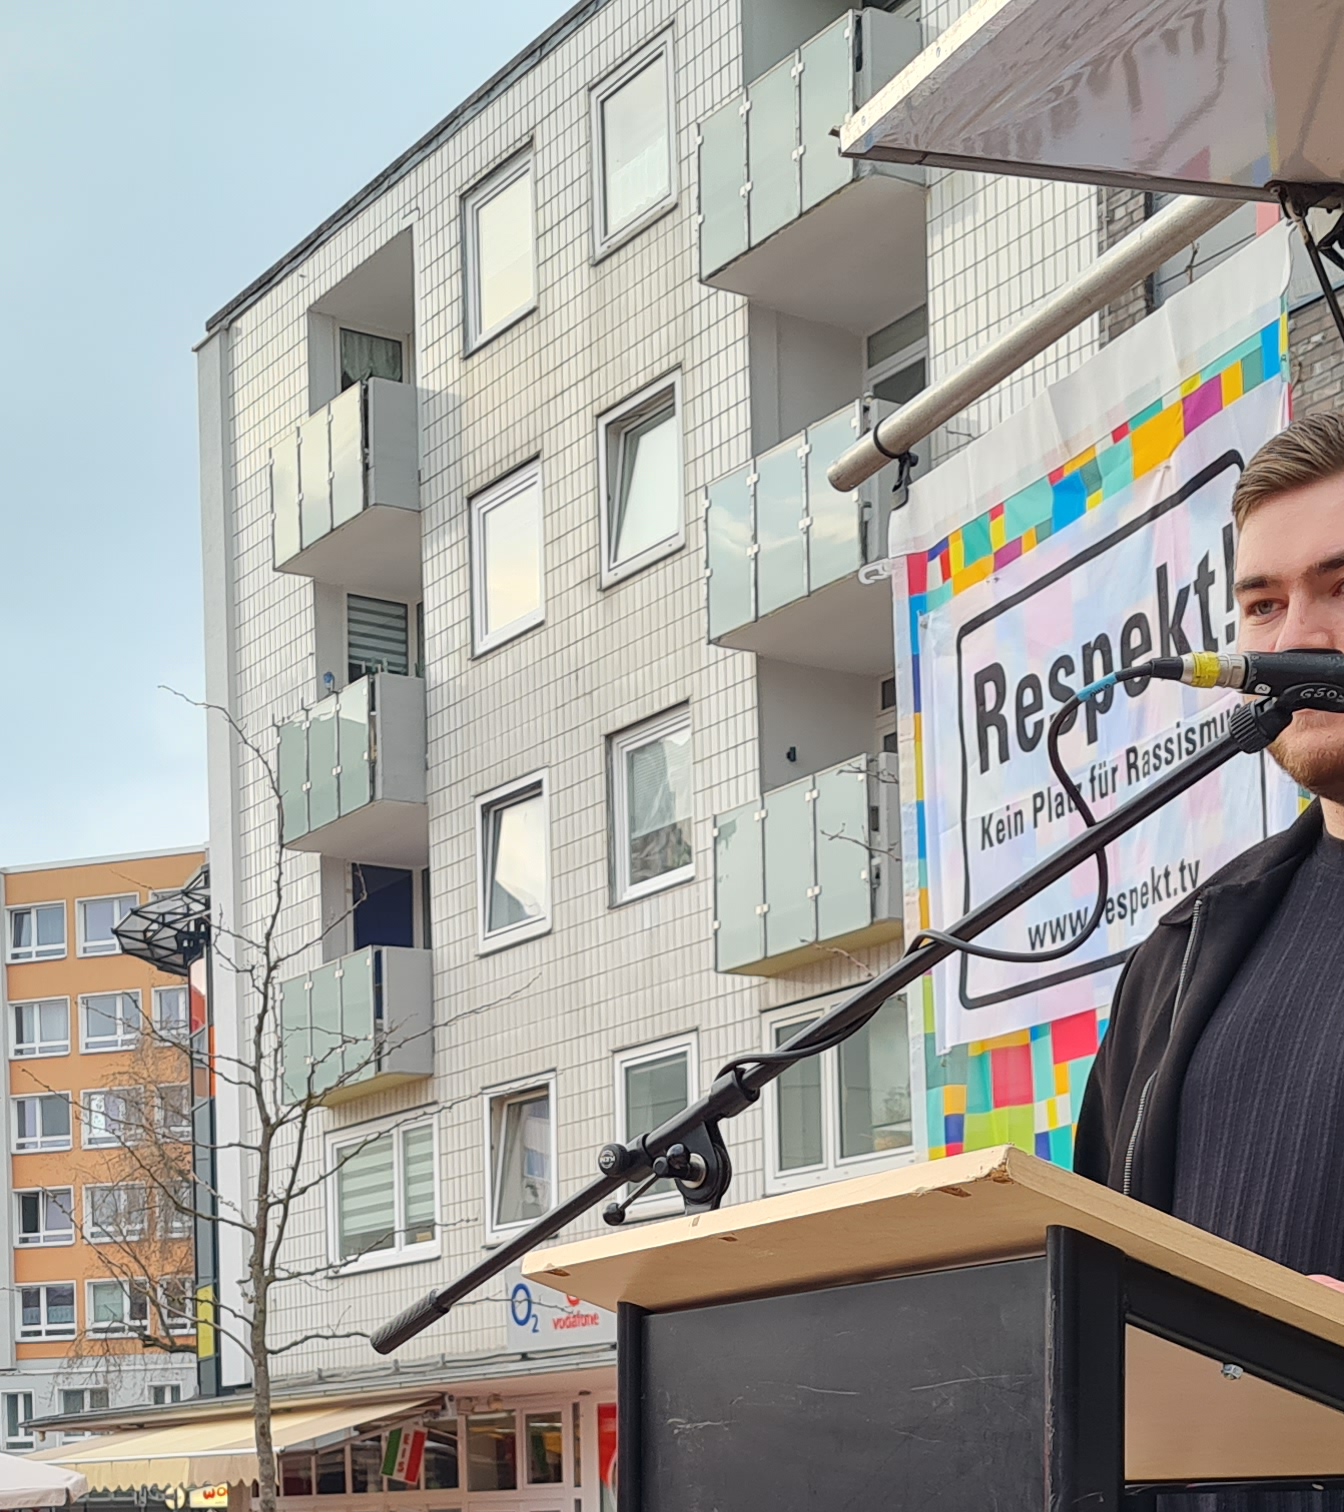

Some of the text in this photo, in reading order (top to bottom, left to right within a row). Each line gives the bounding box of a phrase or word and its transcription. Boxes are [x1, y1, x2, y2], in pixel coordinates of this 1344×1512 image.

[974, 523, 1235, 775] Respekt!
[981, 805, 1025, 851] Kein
[1089, 760, 1119, 803] für
[1027, 859, 1201, 951] wwwespekt.tv
[552, 1310, 600, 1330] vodafone
[396, 1433, 411, 1473] EIS
